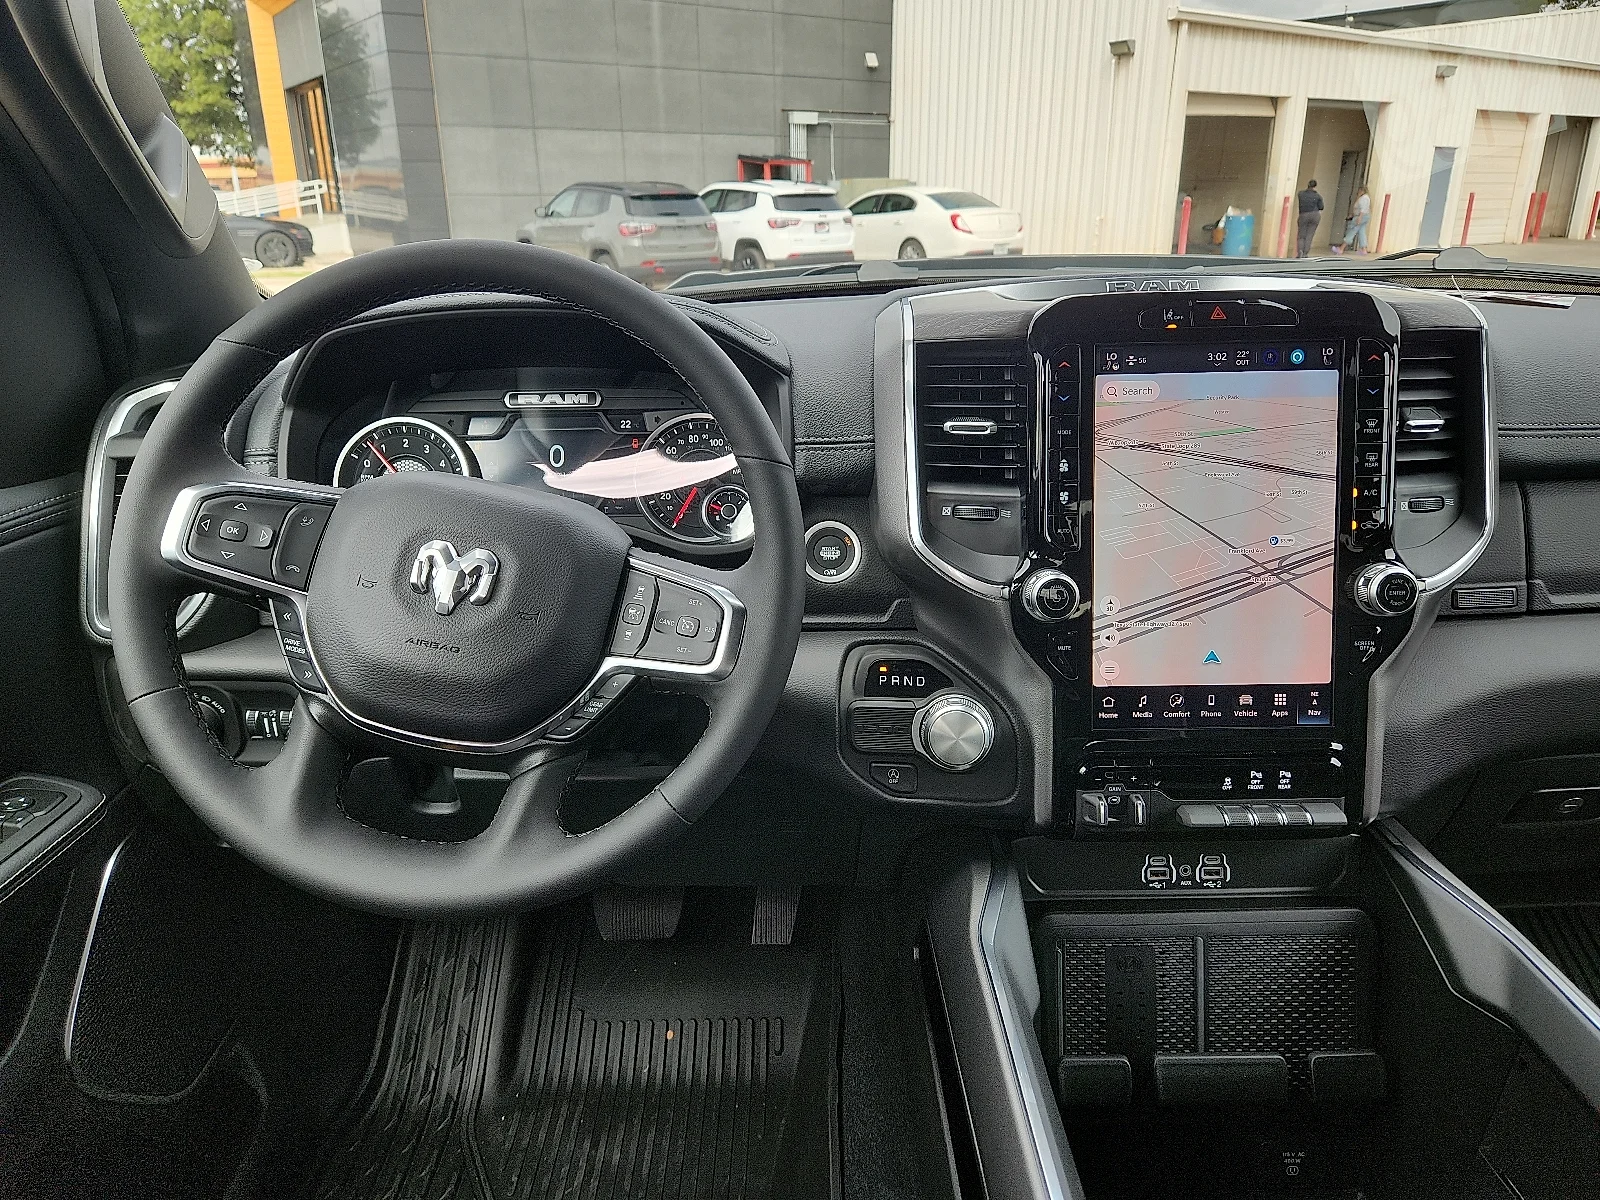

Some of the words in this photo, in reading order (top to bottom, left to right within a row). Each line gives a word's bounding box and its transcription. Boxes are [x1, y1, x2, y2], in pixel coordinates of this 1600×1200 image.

[1106, 280, 1200, 292] RAM
[1106, 352, 1118, 361] LO
[1207, 352, 1228, 361] 3:02
[1322, 347, 1334, 356] LO
[1122, 386, 1154, 397] Search
[517, 393, 589, 405] RAM
[620, 419, 632, 429] 22
[402, 438, 410, 448] 2
[688, 434, 699, 443] 80
[709, 438, 724, 447] 100
[423, 444, 430, 454] 3
[665, 446, 677, 455] 60
[550, 445, 565, 468] 0
[363, 459, 371, 468] 0
[439, 459, 446, 469] 4
[660, 493, 672, 501] 20
[226, 526, 240, 535] OK
[283, 637, 301, 647] DRIVE
[405, 637, 461, 654] AIRBAG
[285, 644, 306, 655] MODES
[211, 701, 226, 714] AUTO
[1271, 710, 1289, 718] Apps
